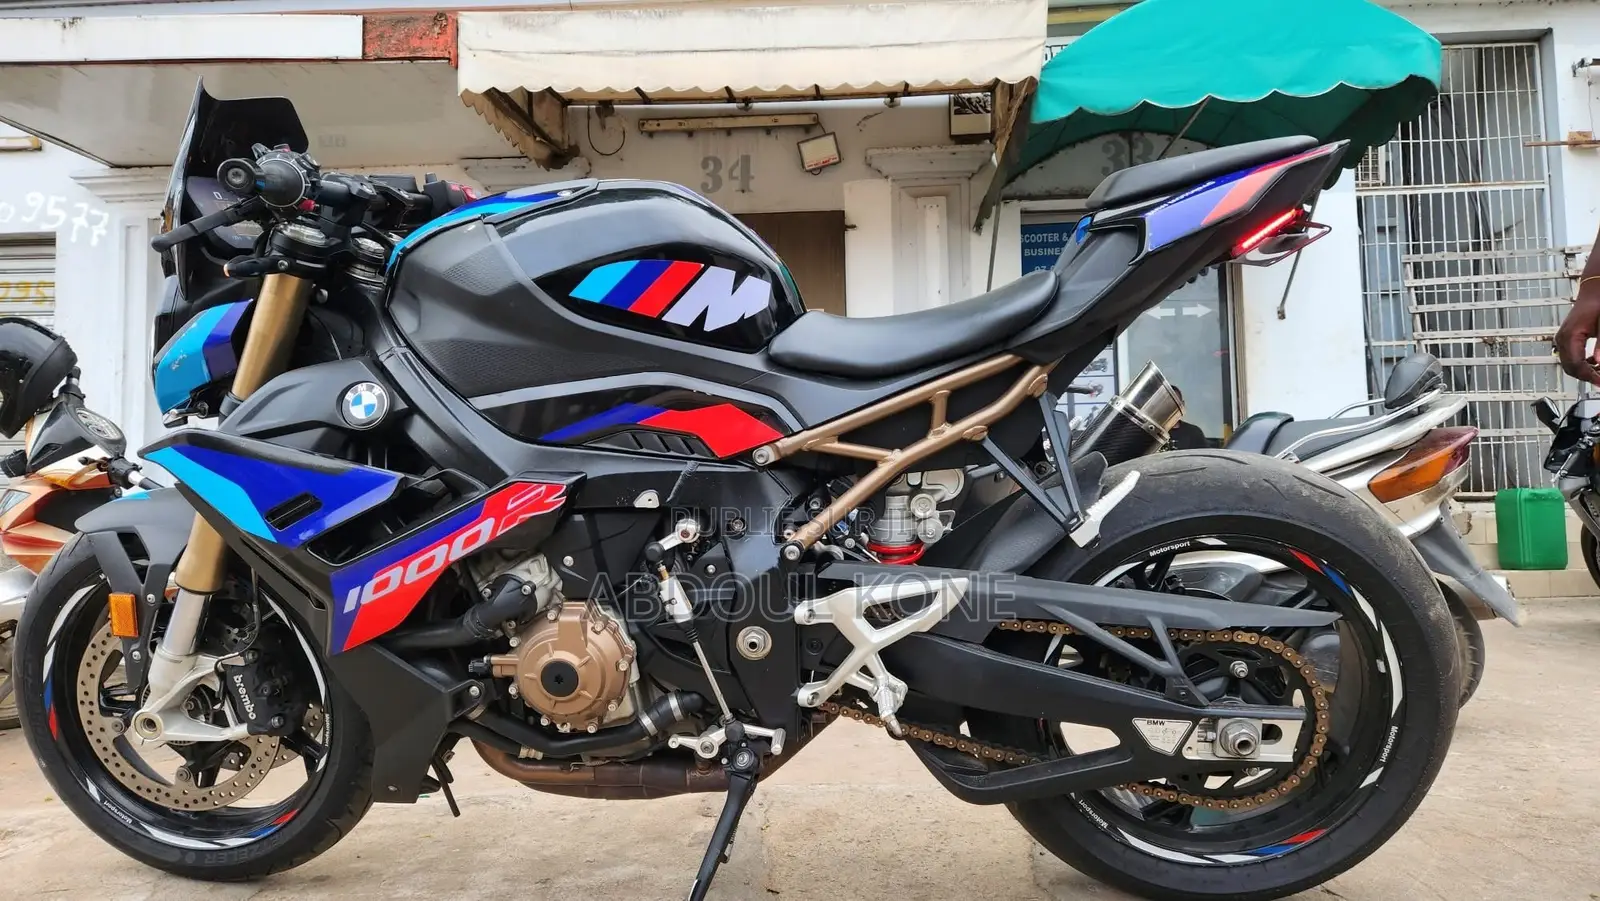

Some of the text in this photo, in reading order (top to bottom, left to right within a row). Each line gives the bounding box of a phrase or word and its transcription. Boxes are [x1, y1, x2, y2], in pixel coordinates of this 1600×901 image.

[700, 155, 755, 194] 34
[345, 383, 383, 401] BMW
[1149, 541, 1191, 557] Motorsport
[233, 673, 257, 720] brembo
[1380, 725, 1399, 763] Motorsport
[103, 800, 133, 824] Motorsport
[1078, 799, 1109, 829] Motorsport
